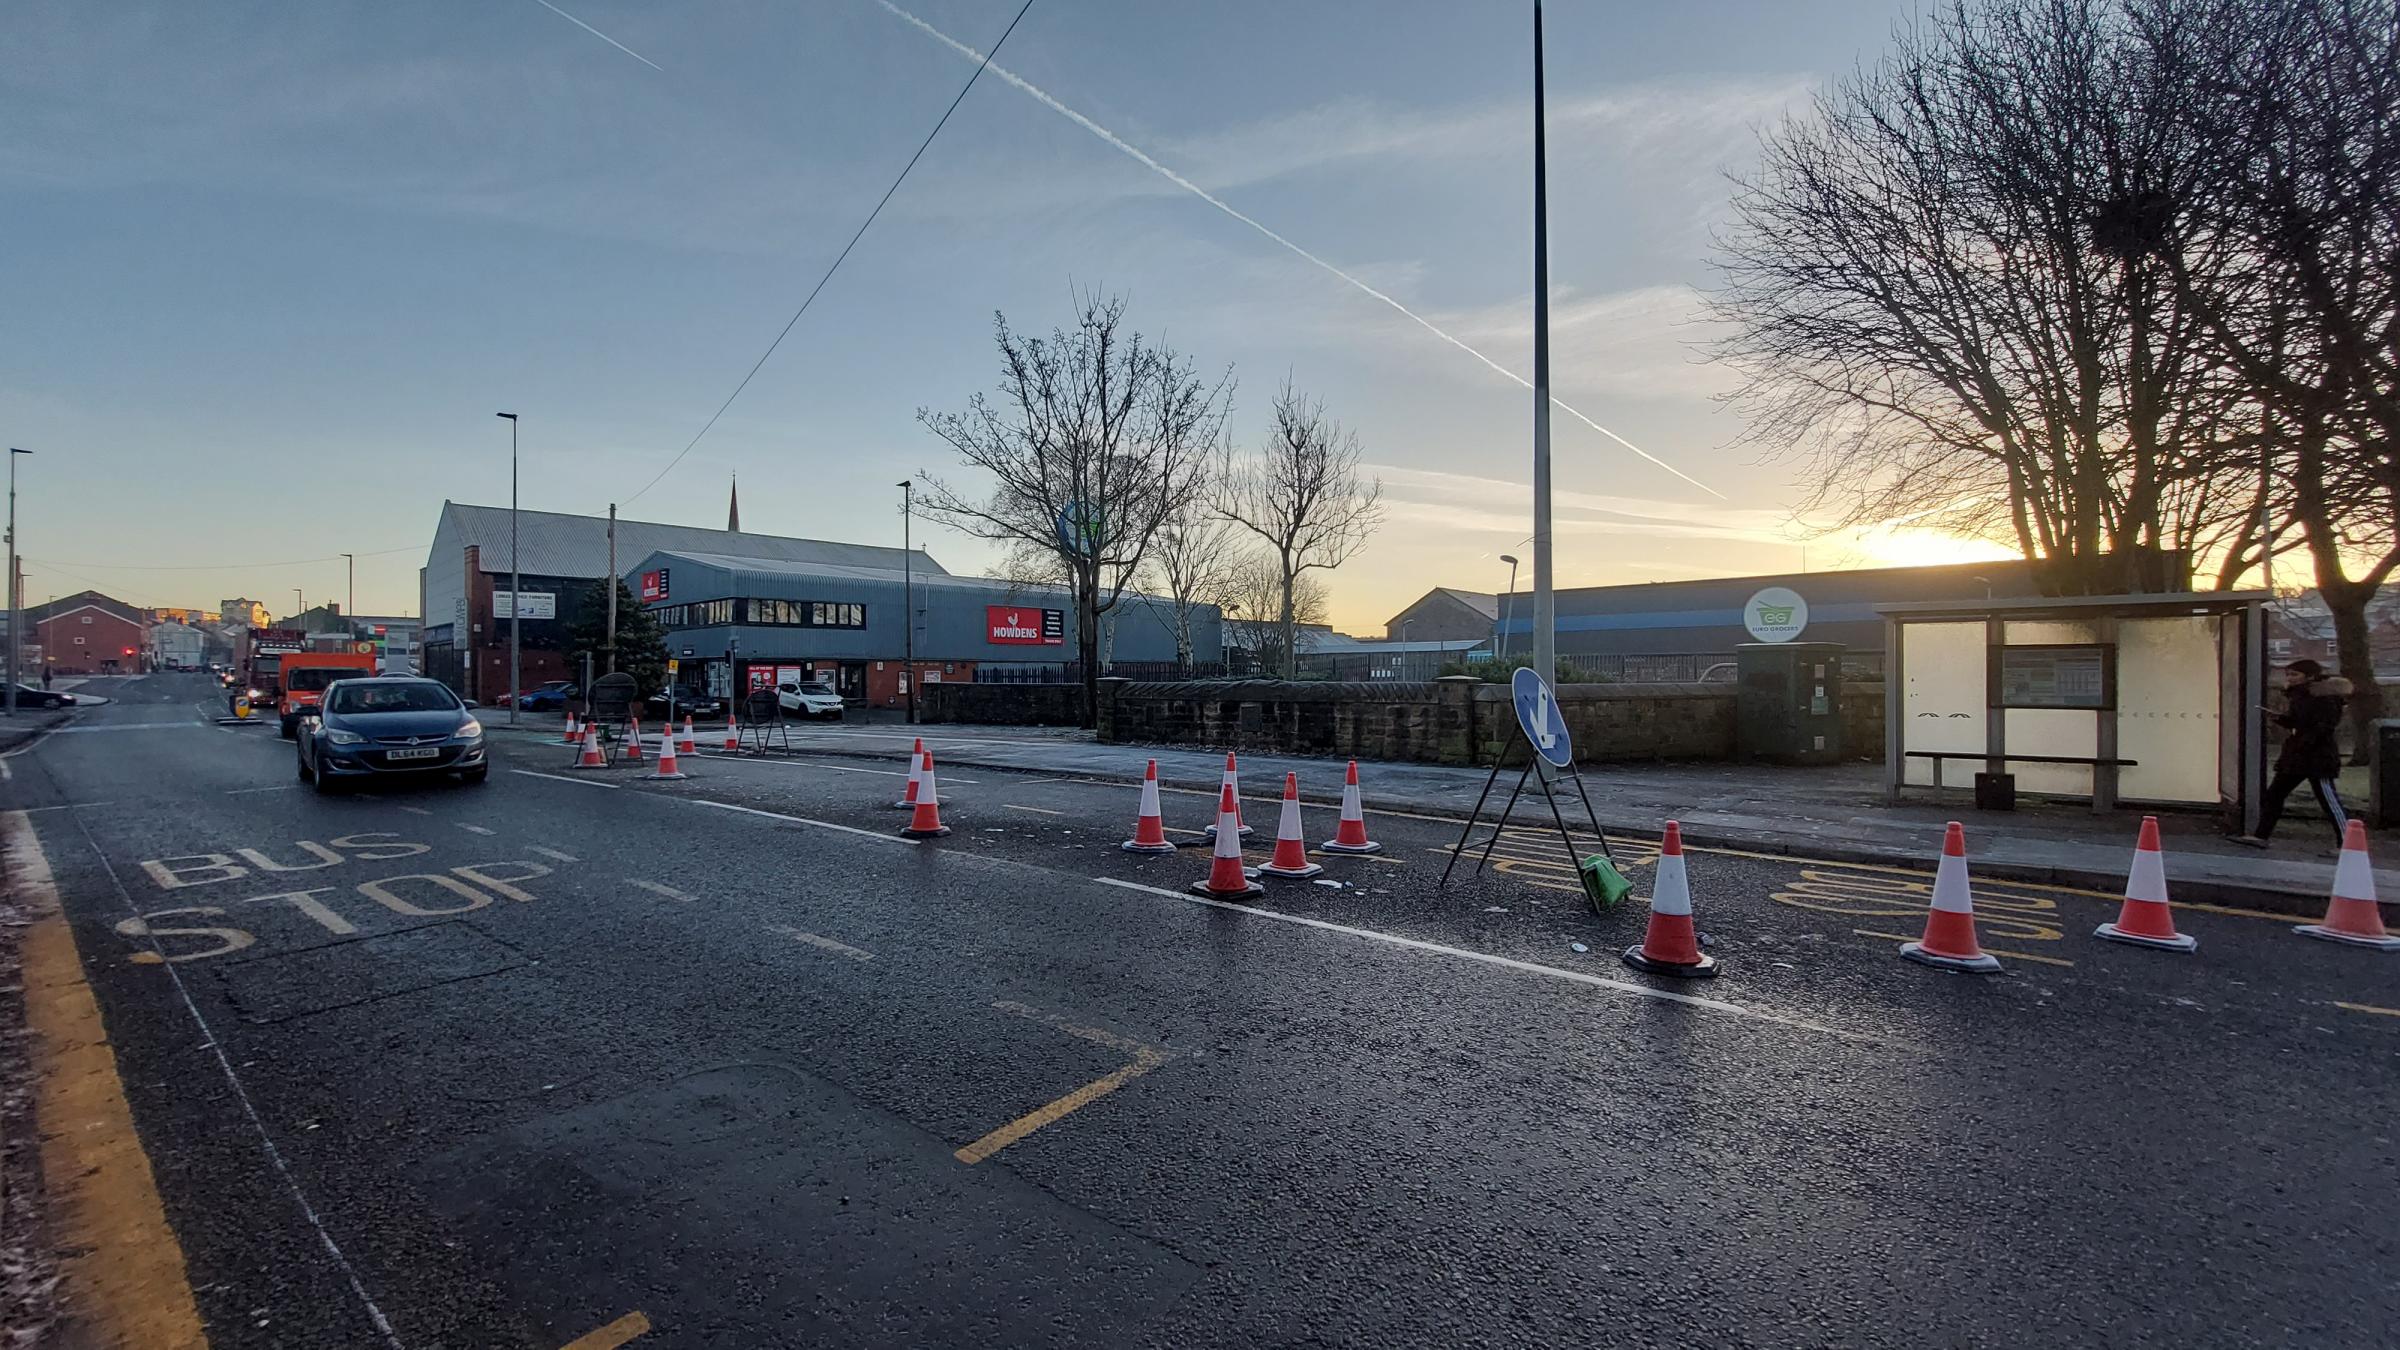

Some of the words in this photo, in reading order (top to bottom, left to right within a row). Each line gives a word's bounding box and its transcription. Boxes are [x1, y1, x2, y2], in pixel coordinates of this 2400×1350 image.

[993, 626, 1037, 638] HOWDENS
[140, 832, 432, 889] BUS
[115, 859, 553, 964] STOP
